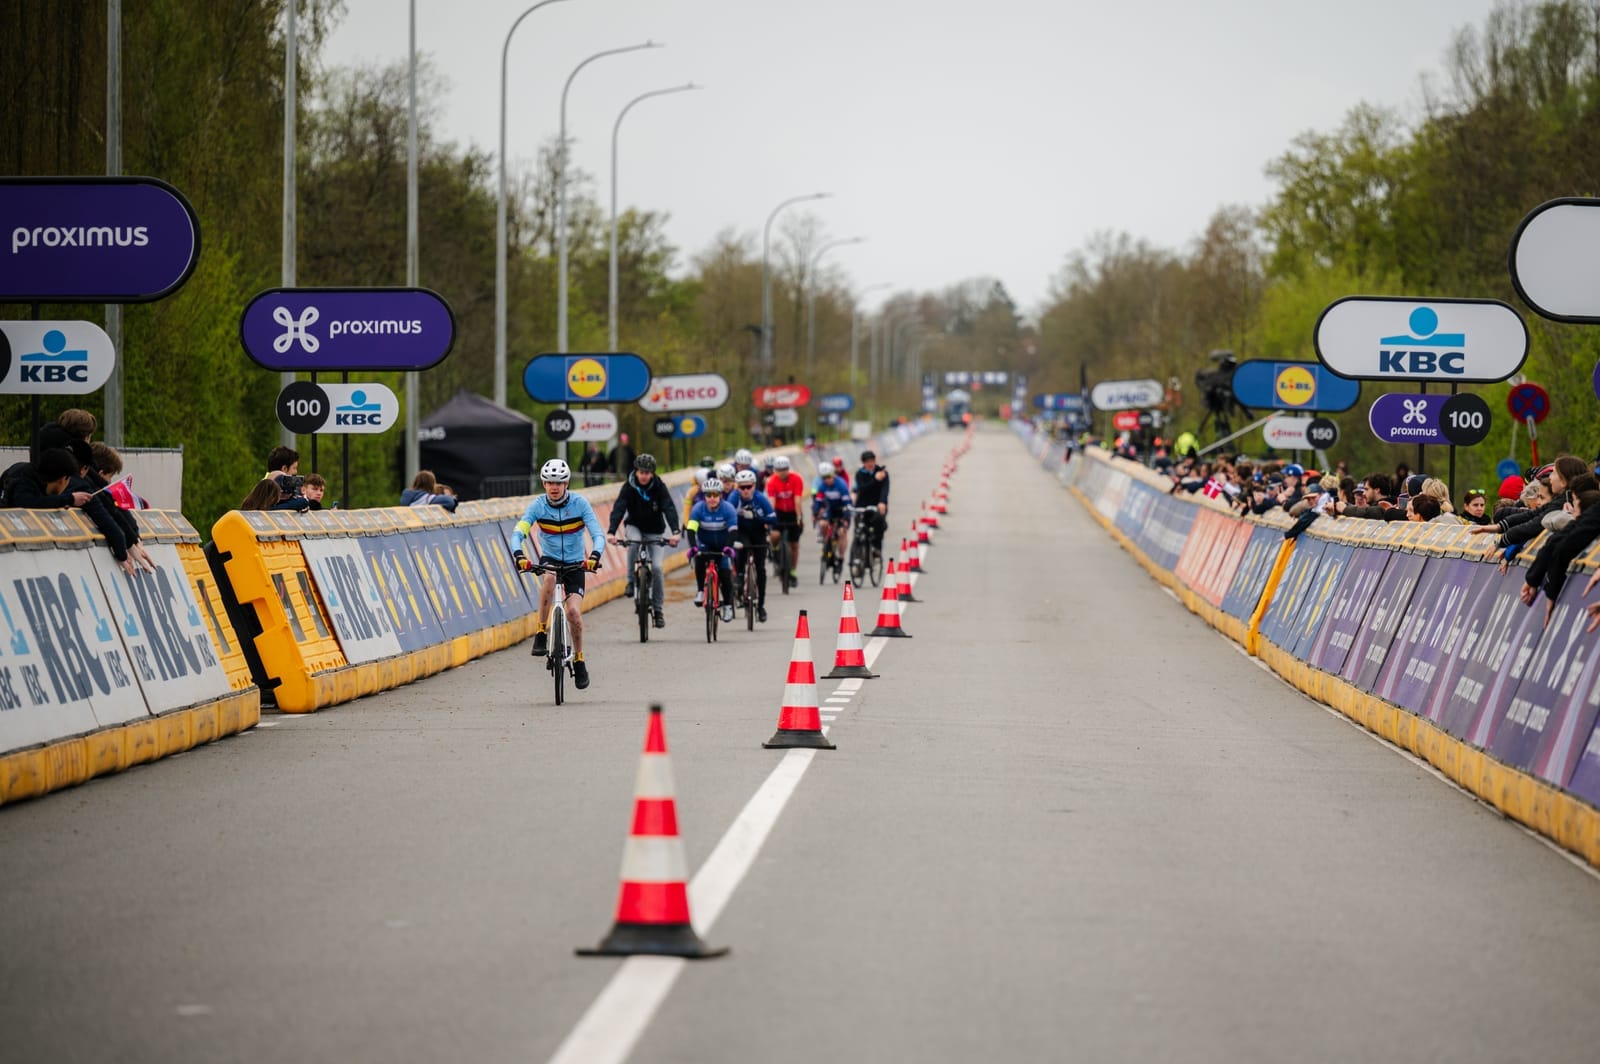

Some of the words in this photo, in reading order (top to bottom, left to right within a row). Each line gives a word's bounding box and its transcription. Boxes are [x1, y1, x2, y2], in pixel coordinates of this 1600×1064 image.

[12, 227, 149, 253] proximus
[329, 320, 422, 339] proximus
[1379, 350, 1465, 374] KBC
[20, 365, 88, 382] KBC
[664, 386, 717, 401] Eneco
[286, 399, 321, 417] 100
[336, 413, 381, 425] KBC
[550, 419, 571, 432] 150
[1449, 411, 1483, 429] 100
[1312, 428, 1333, 440] 150
[1390, 427, 1438, 437] proximus
[324, 554, 382, 641] KBC
[124, 565, 202, 681] KBC
[13, 572, 111, 704] KBC
[104, 650, 131, 688] KBC
[19, 664, 50, 705] KBC
